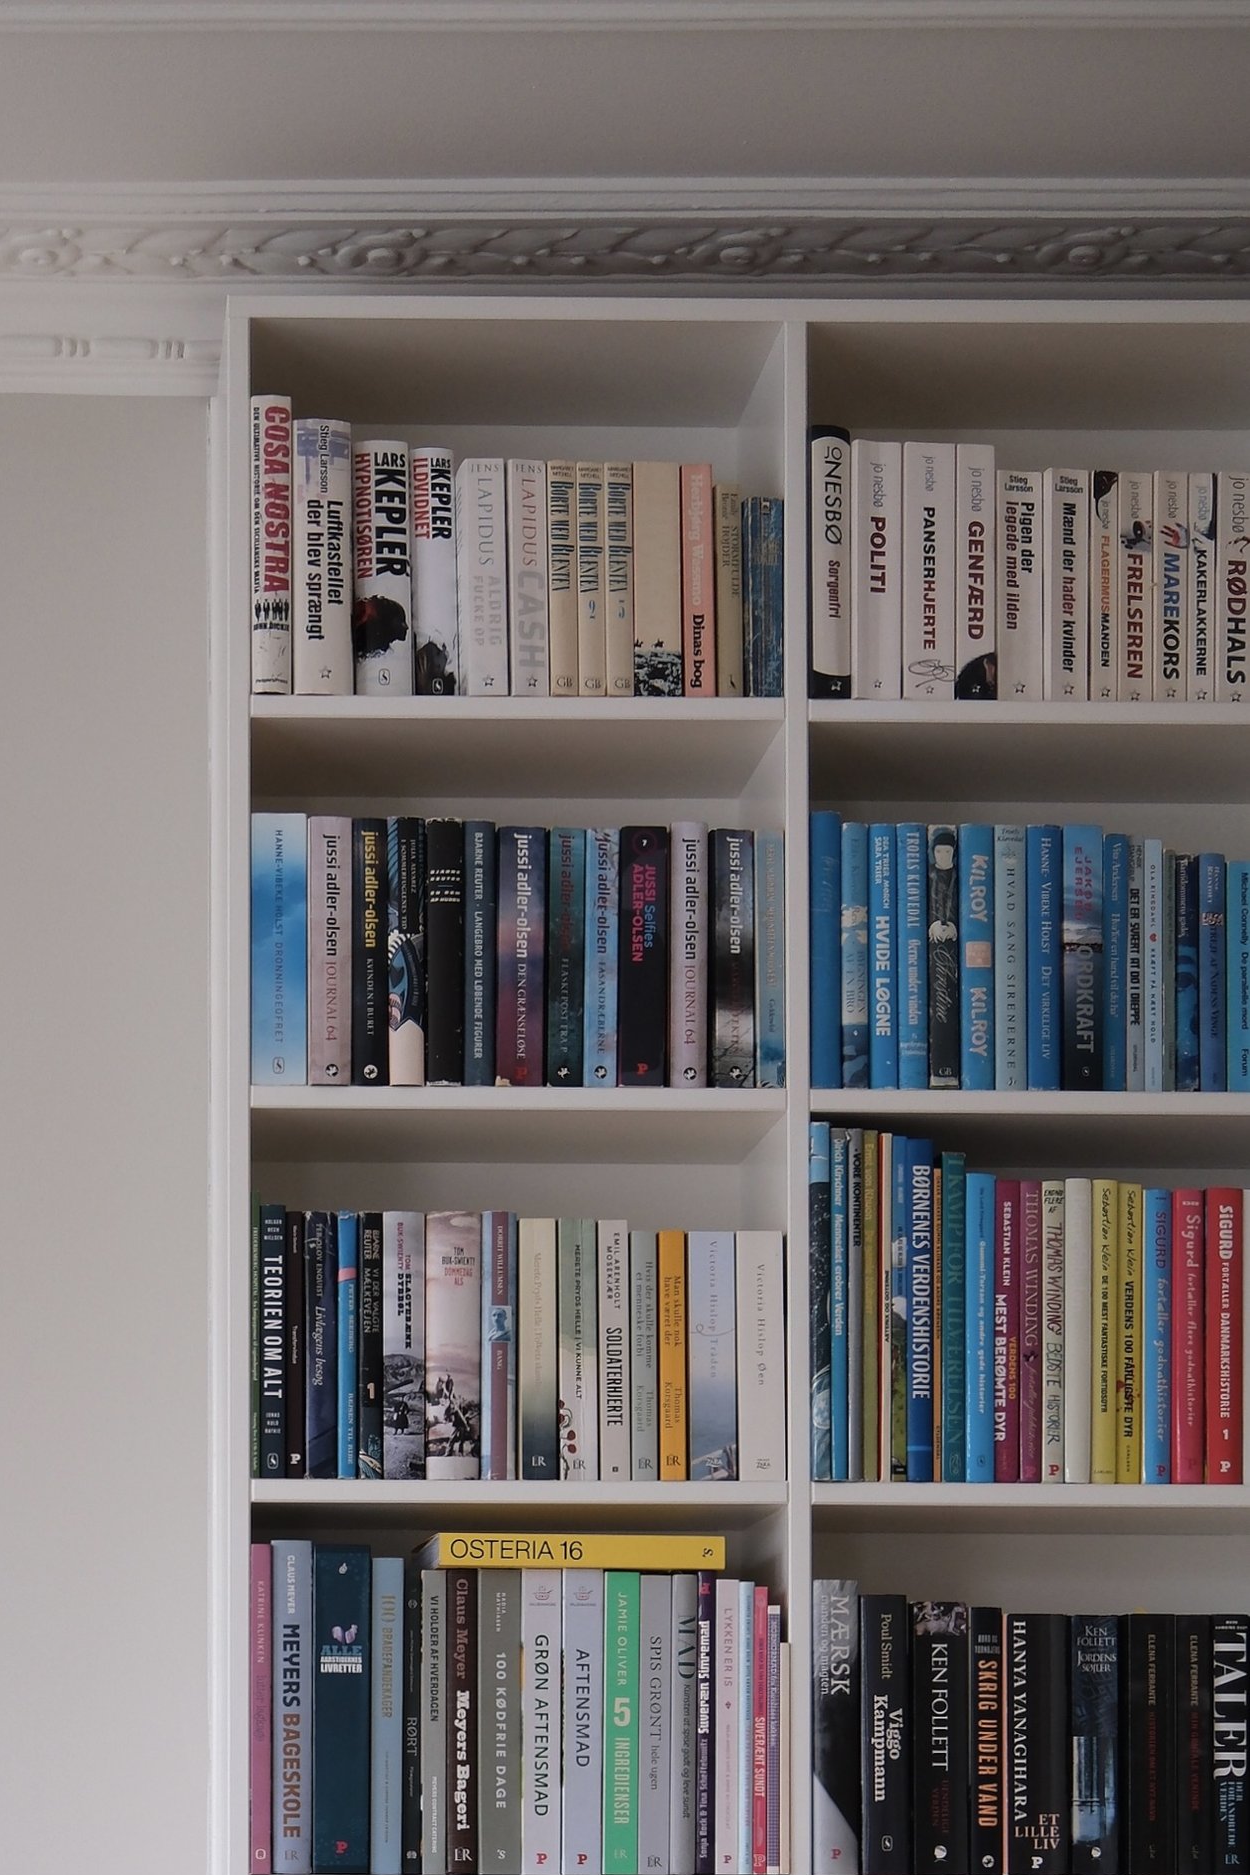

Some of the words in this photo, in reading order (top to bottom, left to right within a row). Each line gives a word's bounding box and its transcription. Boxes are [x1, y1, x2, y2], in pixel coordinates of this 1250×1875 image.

[264, 406, 289, 475] COSA
[319, 425, 329, 450] Stieg
[375, 452, 405, 468] LARS
[431, 458, 451, 468] LARS
[319, 453, 329, 493] Larsson
[413, 458, 429, 539] ILDVIDNET
[307, 500, 324, 528] der
[355, 453, 374, 579] HYPNOTISØREN
[375, 469, 407, 578] KEPLER
[431, 469, 452, 539] KEPLER
[522, 479, 538, 566] LAPIDUS
[825, 460, 842, 545] NESBØ
[1004, 501, 1019, 552] legede
[1020, 502, 1034, 546] Pigen
[1062, 502, 1075, 544] Mænd
[262, 483, 289, 593] NOSTRA
[307, 532, 324, 567] blev
[326, 501, 343, 605] Luftkastellet
[870, 516, 886, 593] POLITI
[1021, 549, 1034, 573] der
[1062, 549, 1075, 572] der
[827, 560, 841, 618] Sorgenfri
[923, 507, 936, 650] PANSERHJERTE
[968, 521, 984, 640] GENFÆRD
[1006, 557, 1019, 588] med
[1062, 577, 1075, 615] hader
[306, 573, 324, 640] sprængt
[518, 571, 545, 668] CASH
[1006, 593, 1019, 630] ilden
[1100, 535, 1110, 667] FLAGERMUSMANDEN
[1127, 554, 1143, 679] FRELSEREN
[1163, 553, 1180, 679] MAREKORS
[1196, 550, 1207, 676] KAKERLAKKERNE
[1227, 560, 1247, 684] RØDHALS
[692, 614, 704, 656] Dinas
[1062, 621, 1076, 673] kvinder
[690, 660, 705, 688] bog
[324, 835, 340, 869] jussi
[474, 832, 483, 865] BJARNE
[515, 834, 531, 869] jussi
[474, 868, 483, 900] REUTER
[970, 855, 988, 922] KILROY
[1007, 868, 1015, 911] HVAD
[326, 873, 341, 956] adler-olsen
[474, 912, 483, 956] LANGEBRO
[516, 873, 532, 957] adler-olsen
[474, 960, 483, 977] MED
[876, 916, 890, 970] HVIDE
[1007, 922, 1015, 964] SANG
[326, 961, 337, 1022] JOURNAL
[474, 980, 483, 1018] LØBENDE
[517, 964, 526, 987] DEN
[1042, 966, 1051, 986] DET
[517, 989, 527, 1059] GRÆNSELØSE
[876, 978, 891, 1035] LØGNE
[969, 987, 987, 1056] KILROY
[1007, 975, 1015, 1069] SIRENERNE
[1042, 992, 1051, 1039] VIRKELIGE
[326, 1026, 337, 1041] 64
[474, 1022, 483, 1058] FIGURER
[1042, 1044, 1051, 1059] LIV
[911, 1166, 931, 1249] BØRNENES
[1003, 1201, 1011, 1255] SEBASTIAN
[264, 1255, 283, 1333] TEORIEN
[1002, 1258, 1011, 1286] KLEIN
[911, 1255, 931, 1398] VERDENSHISTORIE
[995, 1294, 1007, 1333] MEST
[264, 1337, 283, 1361] OM
[994, 1337, 1007, 1408] BERØMTE
[264, 1367, 283, 1398] ALT
[606, 1327, 622, 1426] SOLDATERHJERTE
[995, 1412, 1006, 1441] DYR
[287, 1555, 295, 1582] CLAUS
[450, 1539, 554, 1560] OSTERIA
[560, 1540, 583, 1560] 16
[456, 1579, 468, 1623] Claus
[618, 1592, 628, 1633] JAMIE
[830, 1595, 850, 1695] MÆRSK
[880, 1614, 892, 1641] Poul
[282, 1624, 301, 1707] MEYERS
[454, 1629, 468, 1679] Meyer
[495, 1652, 506, 1680] 100
[535, 1635, 550, 1691] GRØN
[618, 1637, 628, 1685] OLIVER
[880, 1643, 893, 1680] Smidt
[932, 1643, 948, 1682] KEN
[1013, 1621, 1026, 1688] HANYA
[576, 1649, 590, 1767] AFTENSMAD
[978, 1660, 997, 1710] SKRIG
[1213, 1632, 1247, 1779] TALER
[456, 1690, 470, 1760] Meyers
[495, 1687, 507, 1758] KØDFRIE
[614, 1697, 630, 1727] 5
[887, 1708, 903, 1759] Viggo
[931, 1689, 949, 1771] FOLLETT
[535, 1698, 550, 1817] AFTENSMAD
[871, 1695, 887, 1801] Kampmann
[978, 1719, 997, 1775] UNDER
[1014, 1693, 1026, 1821] YANAGIHARA
[283, 1713, 301, 1838] BAGESKOLE
[454, 1764, 470, 1831] Bageri
[495, 1766, 507, 1809] DAGE
[614, 1737, 630, 1824] INGREDIENSER
[979, 1784, 997, 1826] VAND
